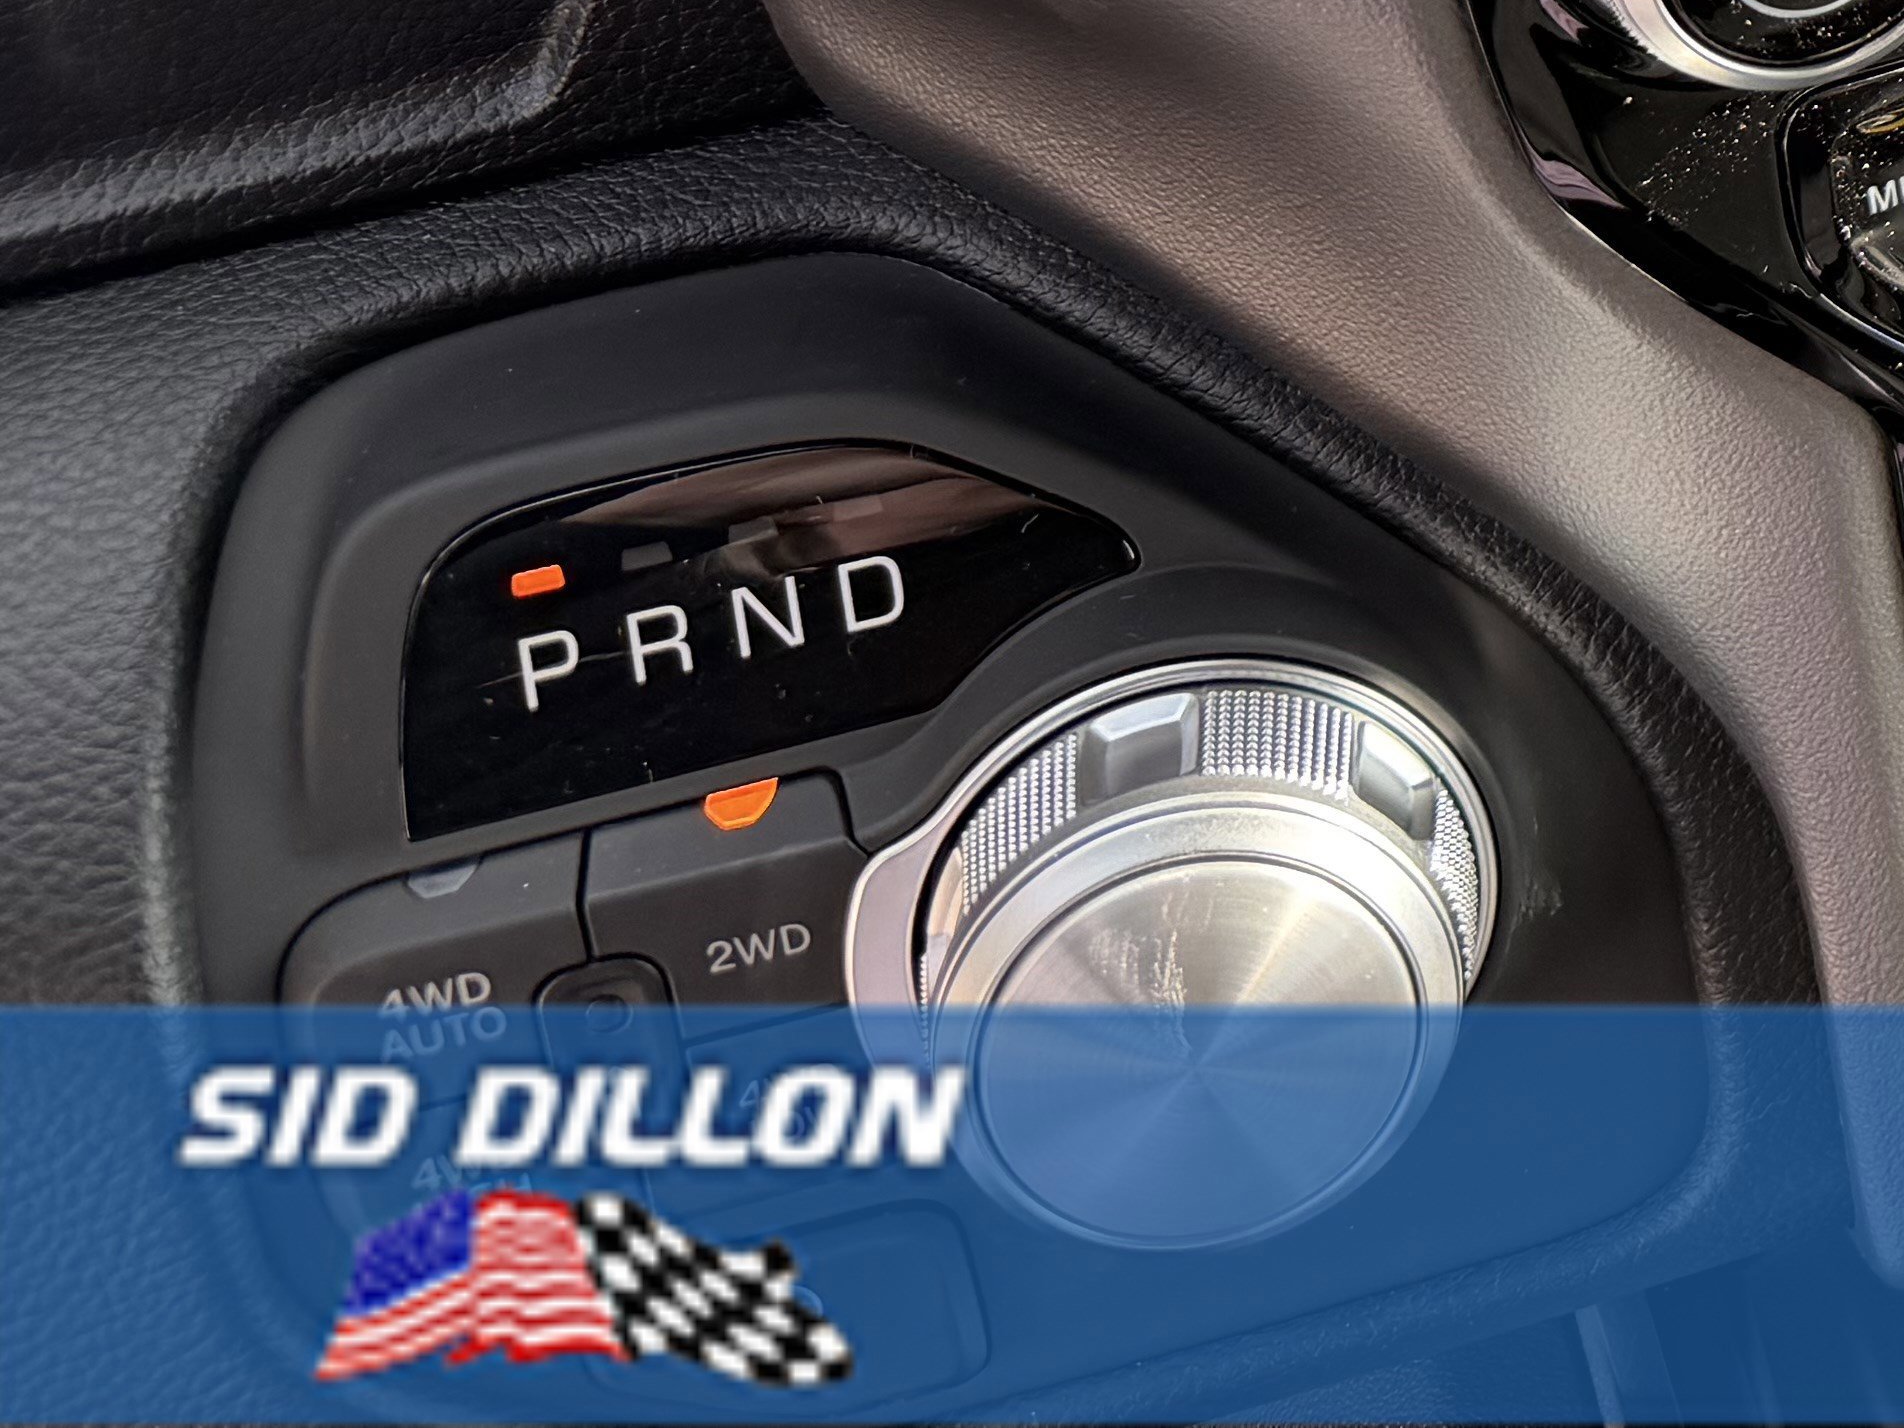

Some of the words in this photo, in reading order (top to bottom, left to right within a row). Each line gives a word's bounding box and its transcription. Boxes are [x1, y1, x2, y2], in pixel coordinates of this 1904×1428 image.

[515, 629, 579, 711] P
[627, 605, 694, 684] R
[730, 575, 805, 660] N
[837, 555, 906, 633] D
[706, 921, 812, 974] 2WD
[379, 972, 491, 1020] 4WD
[380, 1006, 506, 1062] AUTO
